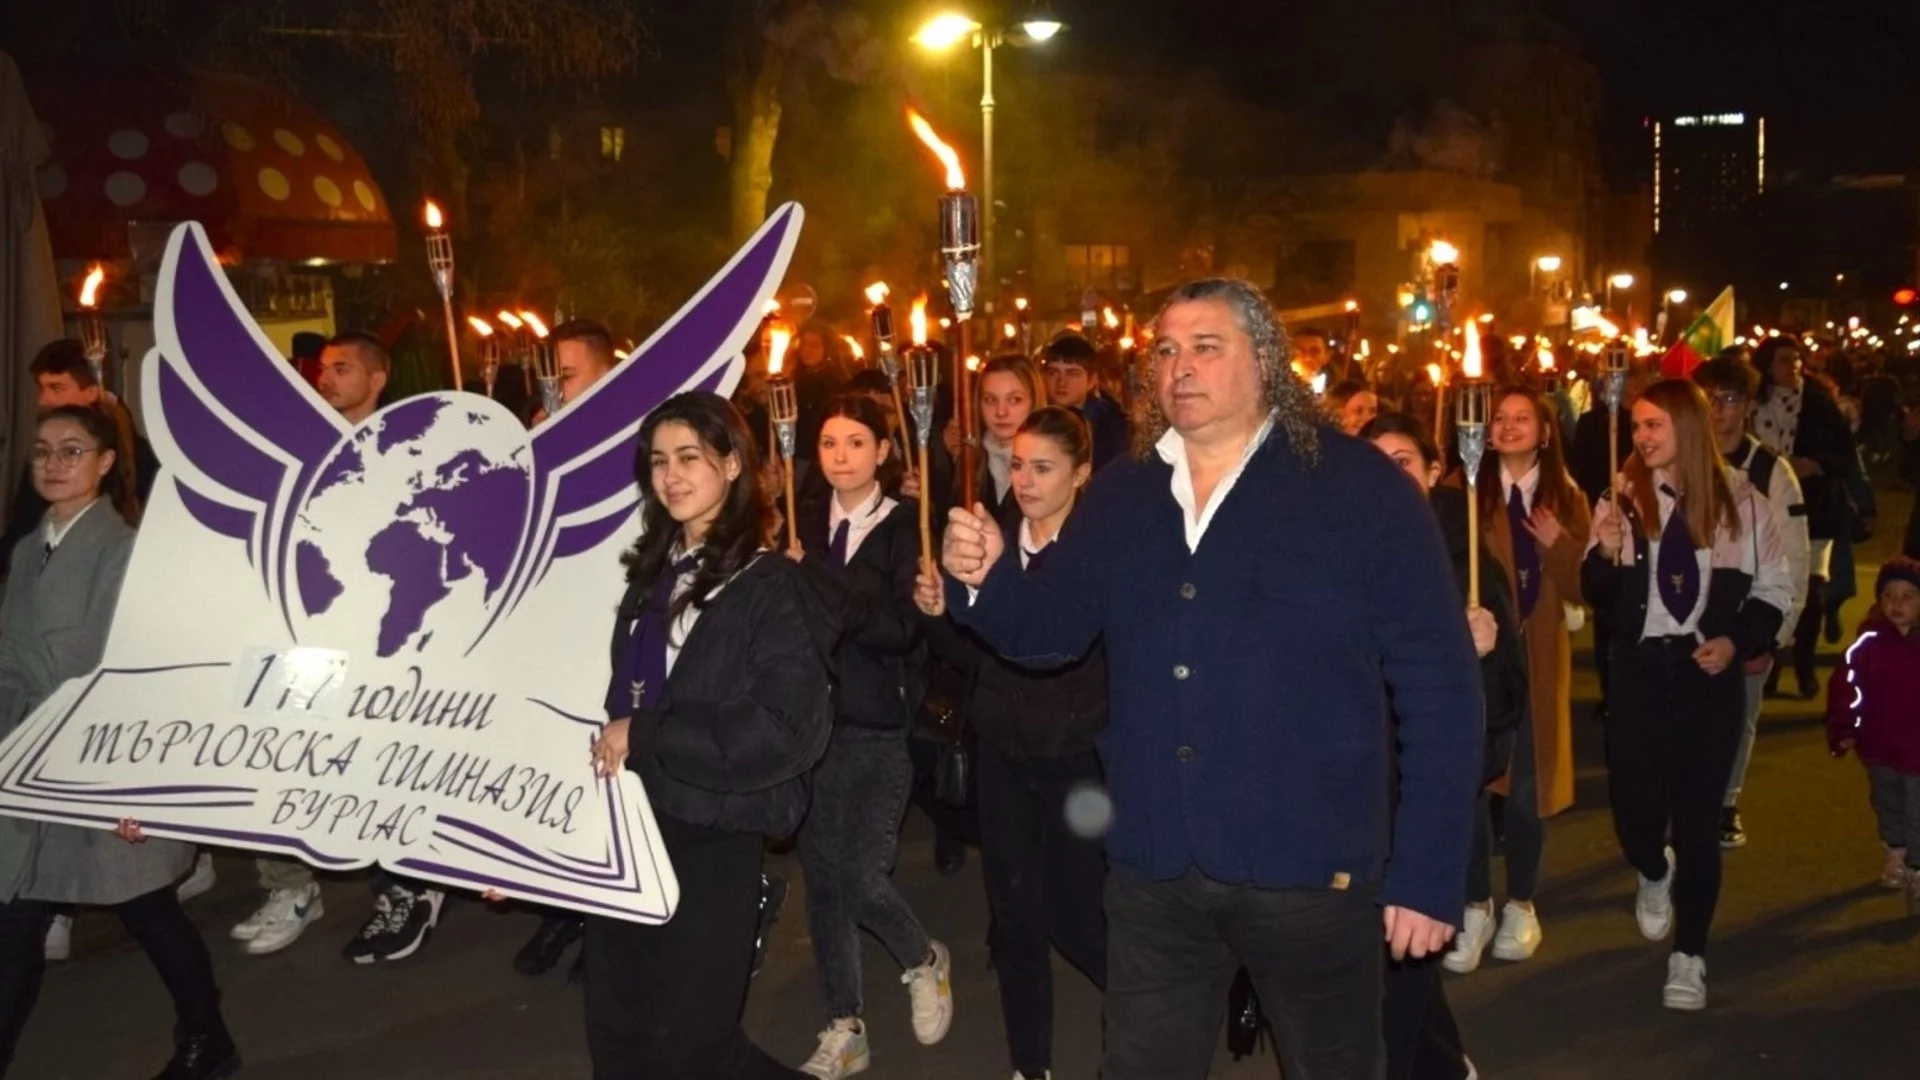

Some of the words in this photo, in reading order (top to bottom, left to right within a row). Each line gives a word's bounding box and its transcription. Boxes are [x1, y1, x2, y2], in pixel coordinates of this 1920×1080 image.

[347, 665, 497, 731] години
[79, 718, 362, 777] ТЪРГОВСКА
[375, 738, 584, 834] ГИМНАЗИЯ
[271, 786, 428, 848] БУРГАС
